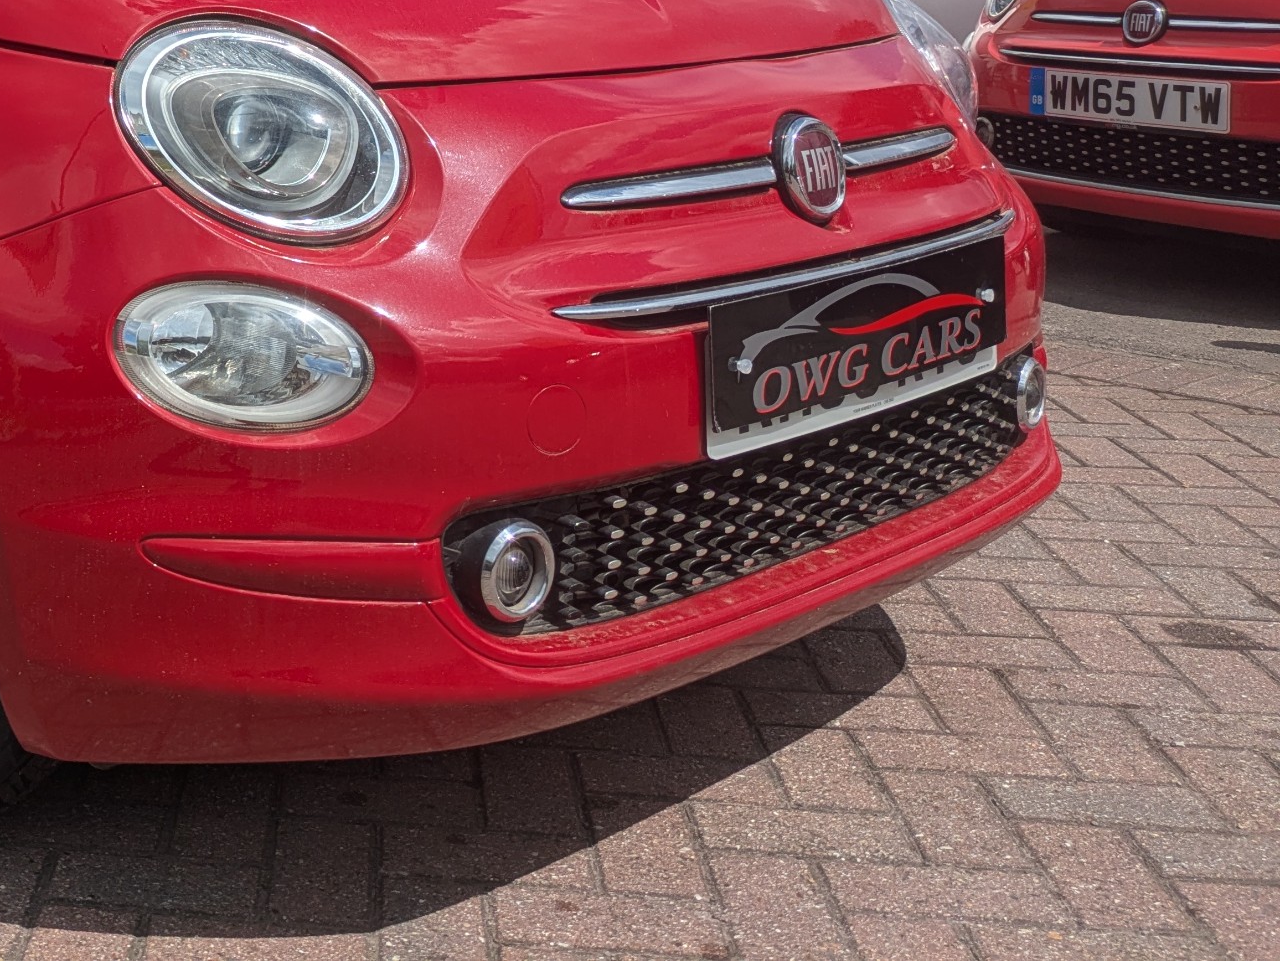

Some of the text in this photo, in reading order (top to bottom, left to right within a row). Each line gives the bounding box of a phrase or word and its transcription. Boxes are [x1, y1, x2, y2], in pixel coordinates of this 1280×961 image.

[1129, 12, 1153, 33] FIAT
[1032, 95, 1043, 105] GB
[1050, 74, 1222, 125] WM65 VTW
[801, 146, 836, 193] FIAT
[752, 309, 981, 414] OWG CARS
